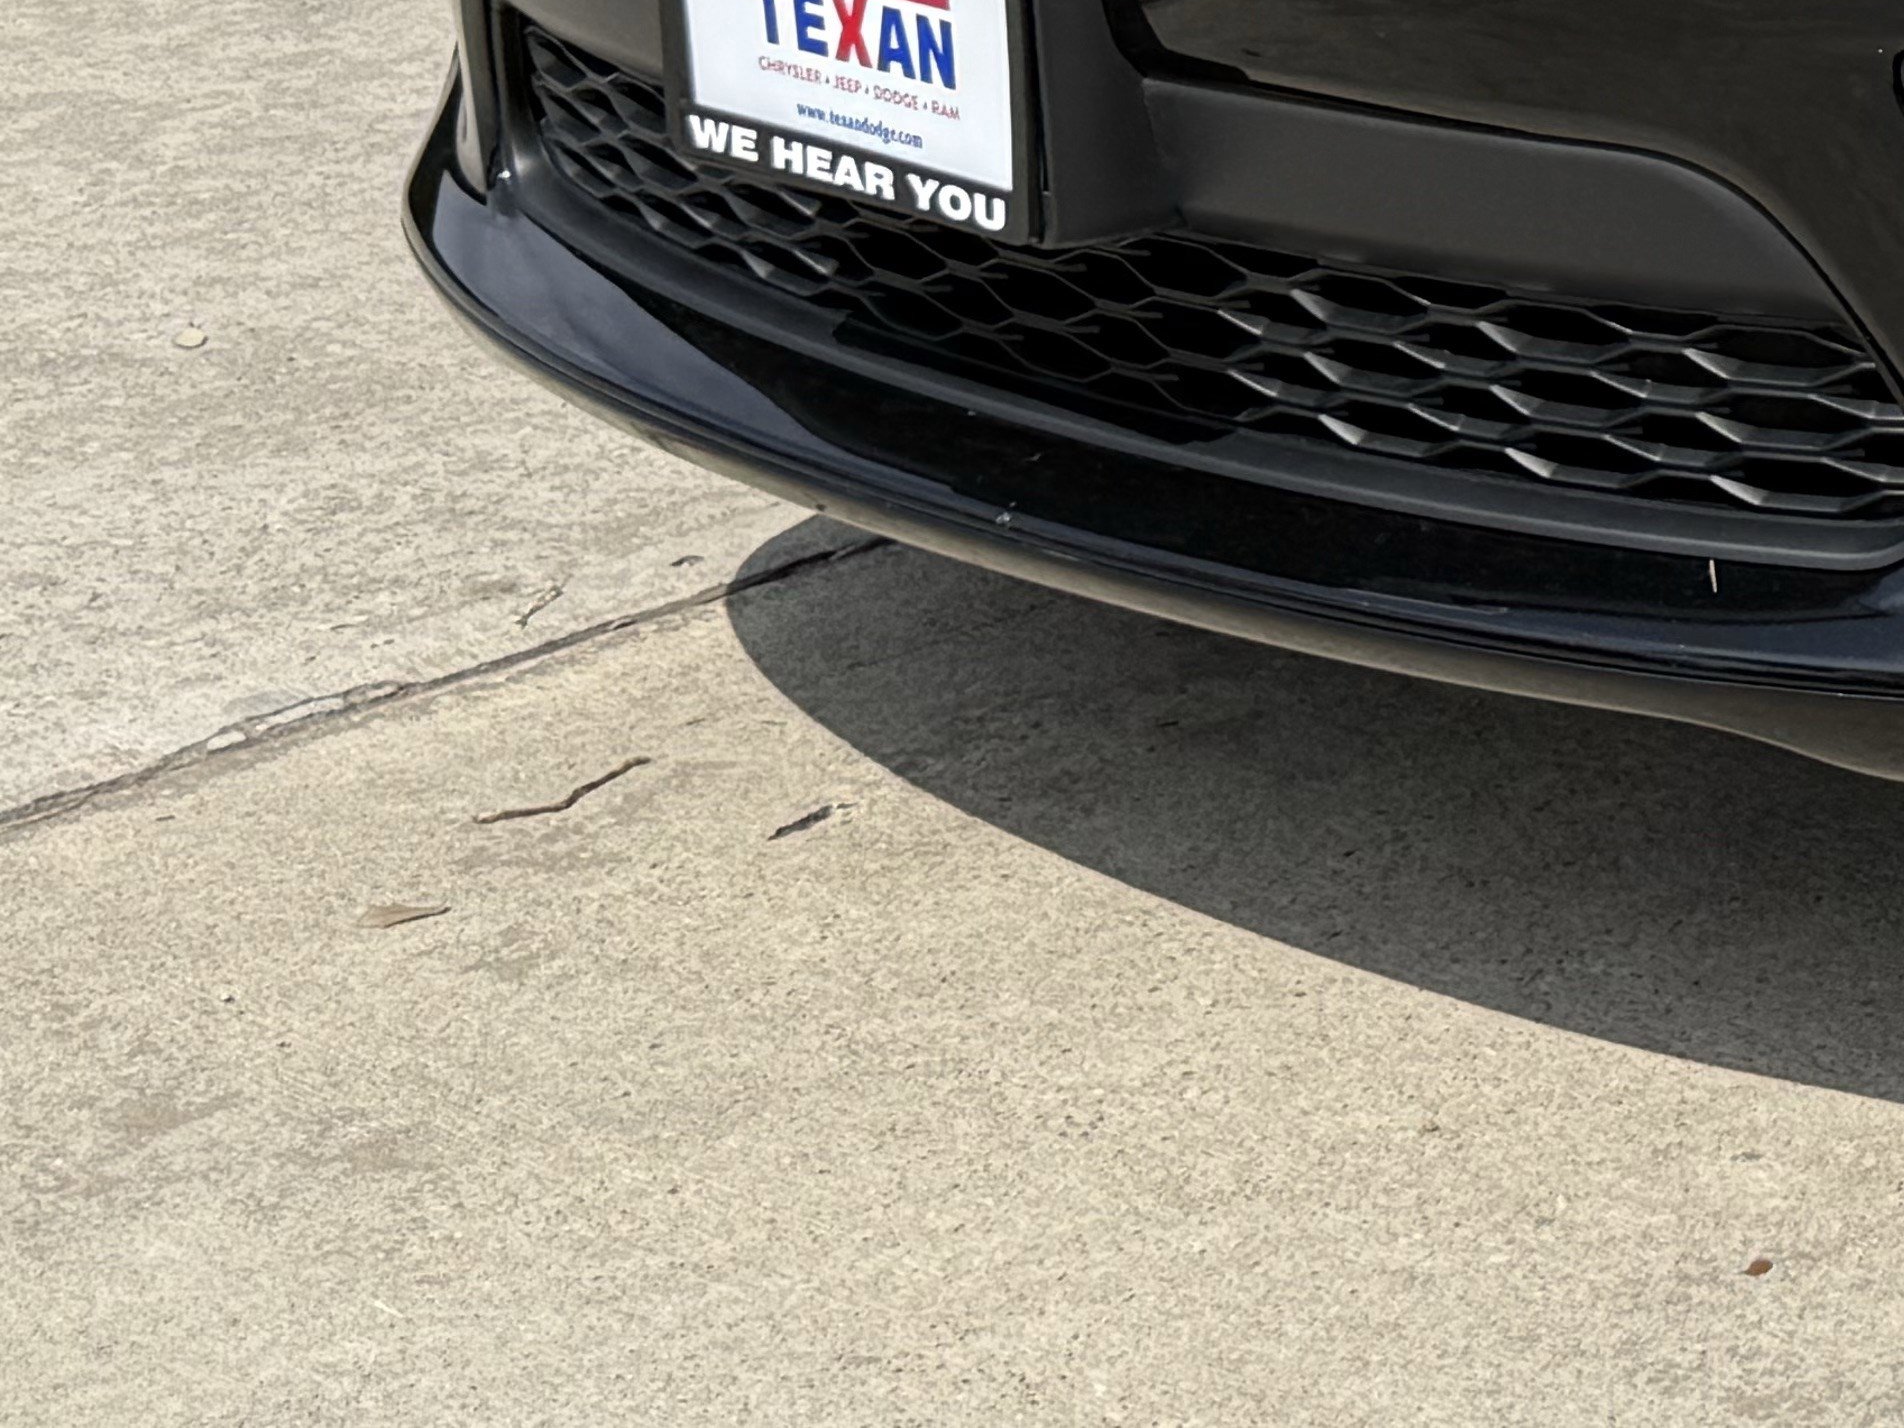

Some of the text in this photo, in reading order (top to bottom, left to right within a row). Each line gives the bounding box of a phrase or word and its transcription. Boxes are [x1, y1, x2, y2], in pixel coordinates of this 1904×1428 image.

[758, 55, 961, 121] CHRYSLER JEEP DODGE RAM
[796, 102, 923, 149] www.texandodge.com
[686, 114, 1007, 232] WE HEAR YOU
